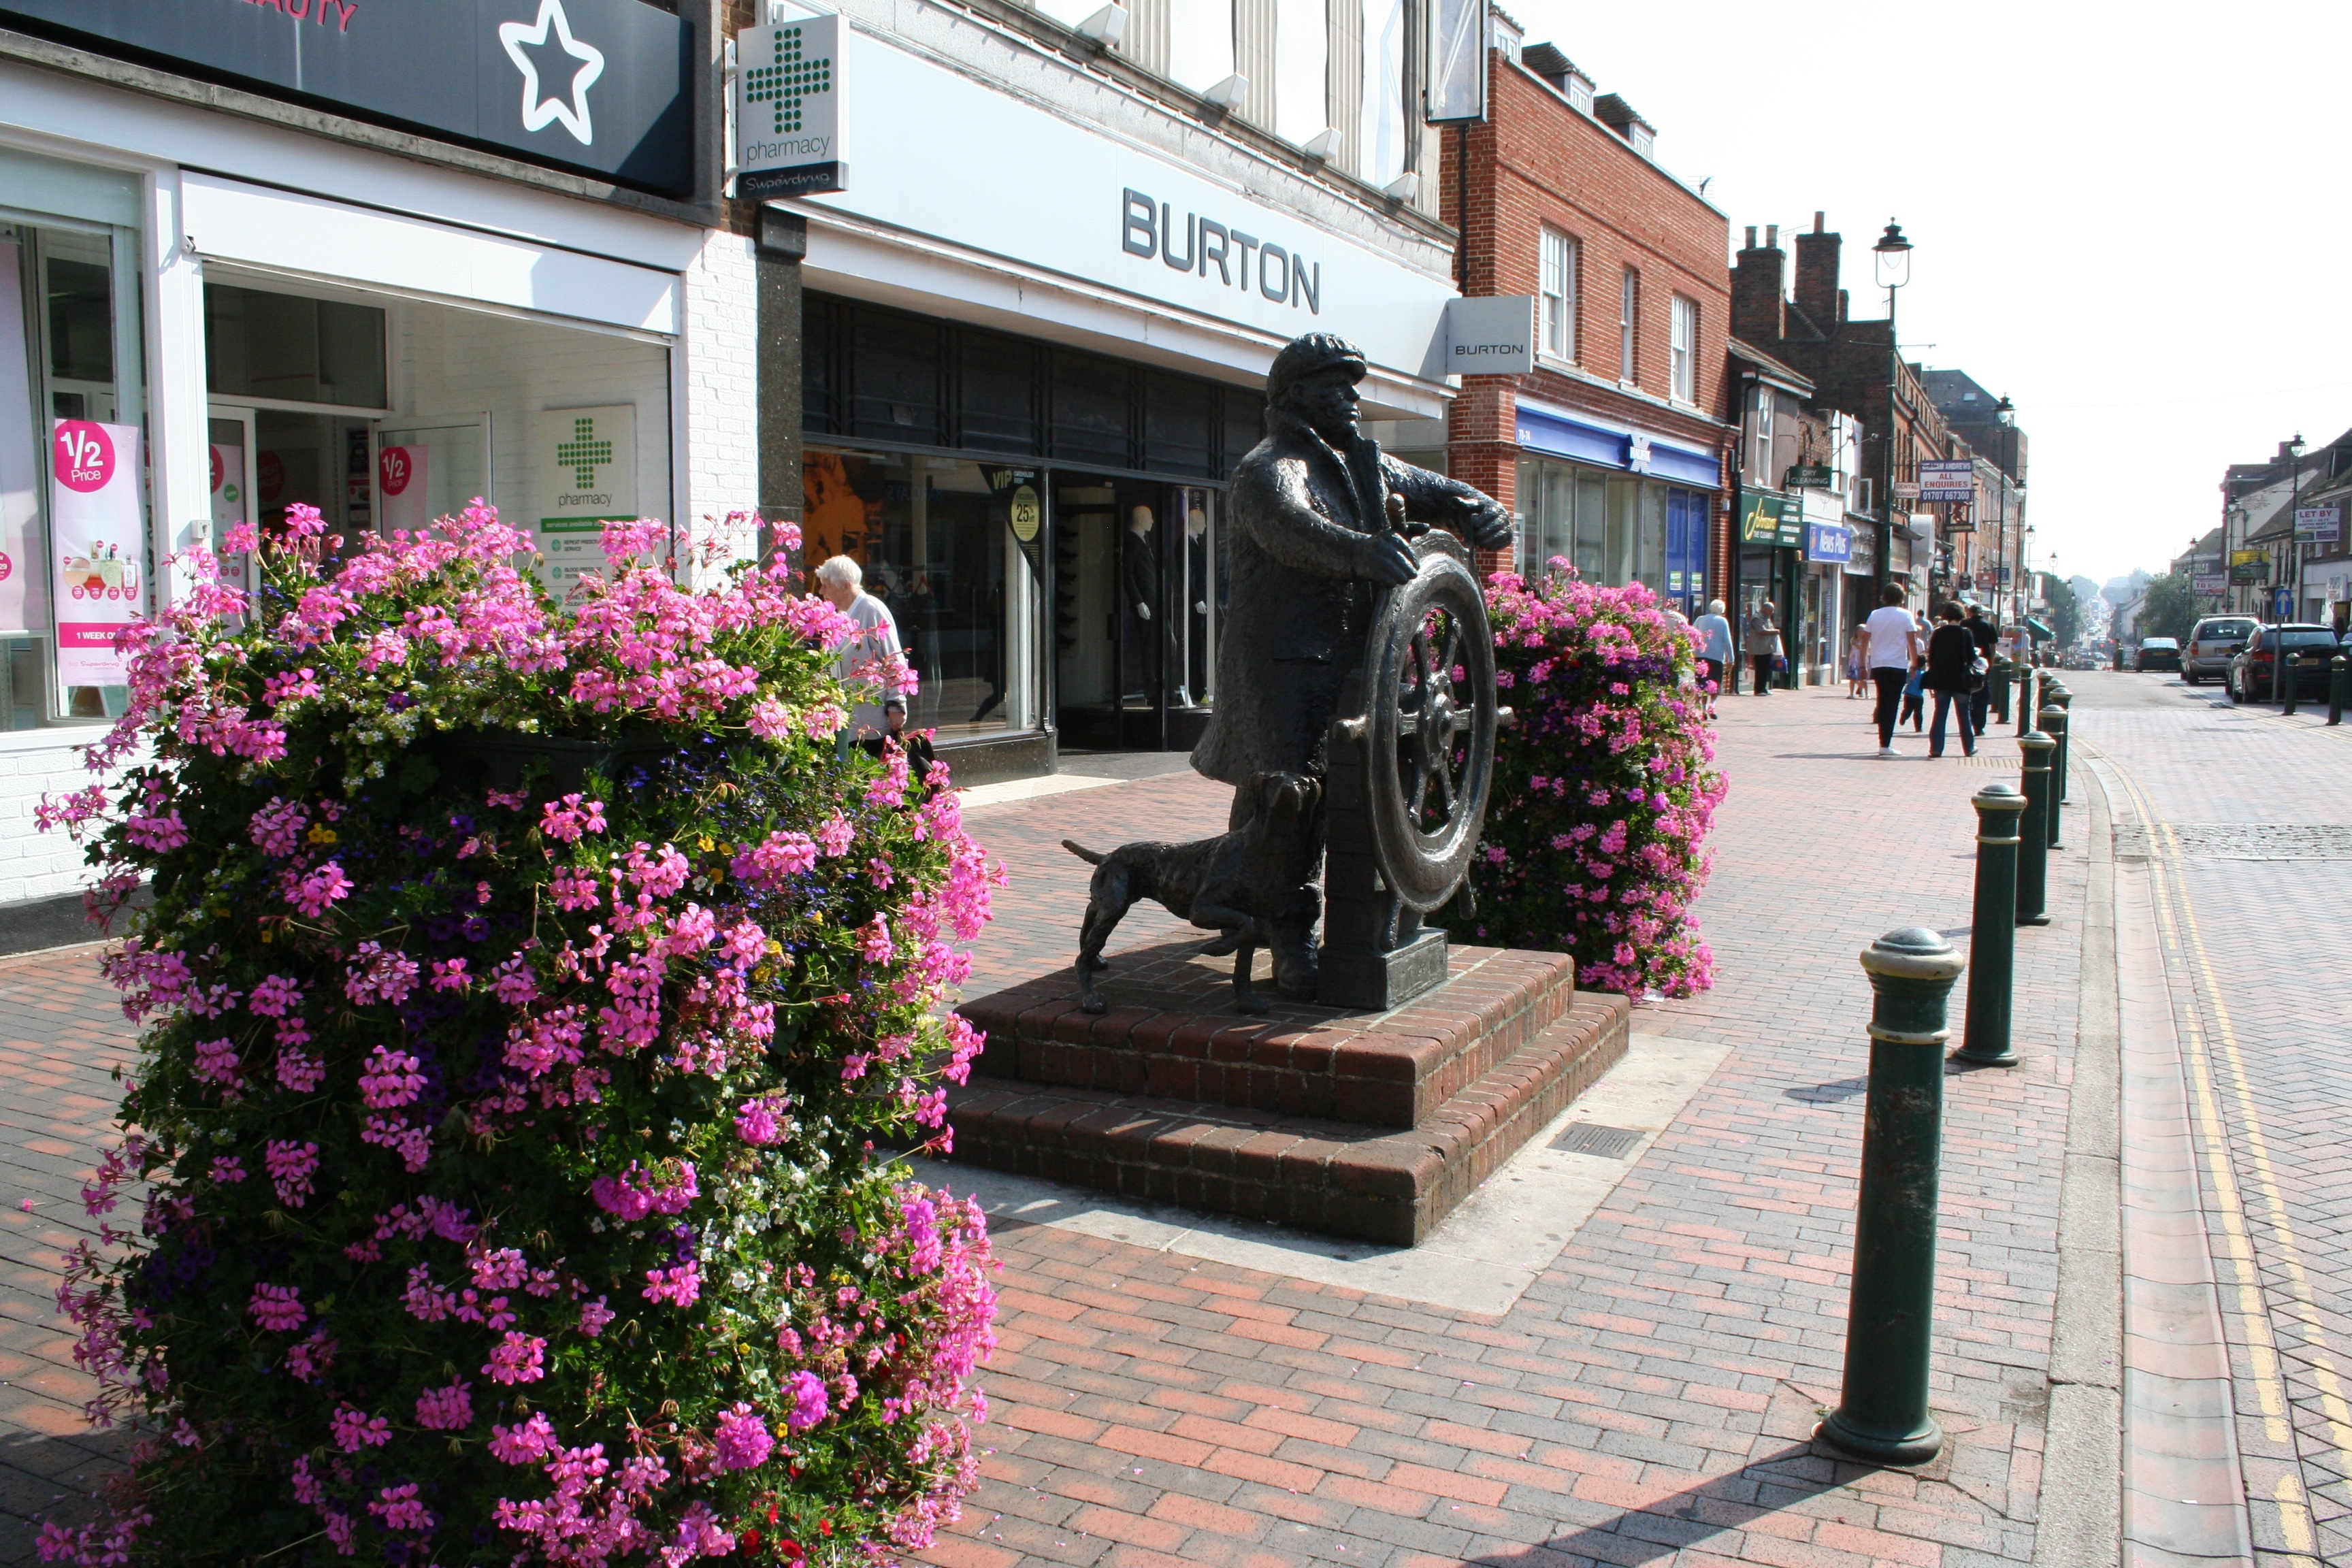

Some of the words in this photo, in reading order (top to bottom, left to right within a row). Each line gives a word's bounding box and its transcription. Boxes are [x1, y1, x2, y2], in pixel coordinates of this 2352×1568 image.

[747, 136, 830, 165] pharmacy
[746, 173, 830, 190] Superdrug
[1123, 187, 1319, 315] BURTON
[1455, 344, 1524, 355] BURTON
[60, 430, 103, 469] 1/2
[71, 468, 101, 483] Price
[993, 470, 1012, 490] VIP
[558, 493, 612, 508] pharmacy
[1923, 491, 1943, 500] 01707
[1944, 491, 1970, 500] 667300
[1819, 530, 1835, 553] News
[1834, 533, 1847, 555] Plus
[76, 632, 81, 640] 1
[82, 632, 106, 640] WEEK
